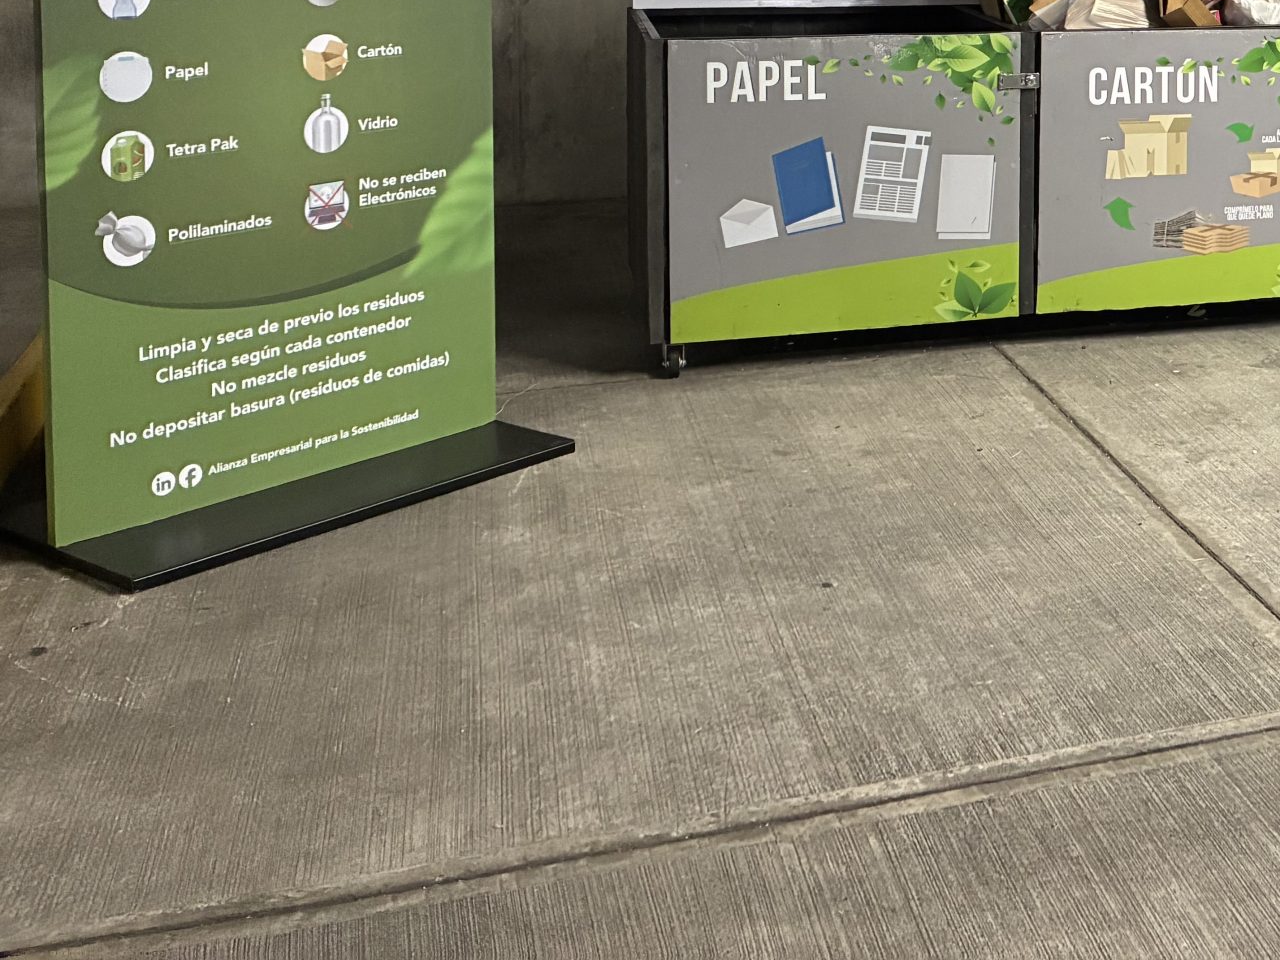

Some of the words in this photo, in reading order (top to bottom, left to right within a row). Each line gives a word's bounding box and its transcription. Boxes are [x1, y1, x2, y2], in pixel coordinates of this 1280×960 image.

[357, 44, 403, 59] Cartón
[165, 63, 209, 82] Papel
[705, 59, 827, 104] PAPEL
[1087, 58, 1220, 106] CARTÓN
[358, 116, 398, 131] Vidrio
[166, 141, 207, 157] Tetra
[211, 136, 239, 151] Pak
[359, 177, 379, 190] No
[382, 176, 397, 187] se
[400, 168, 447, 184] reciben
[359, 186, 437, 207] Electrónicos
[168, 213, 273, 243] Polilaminados
[138, 340, 197, 362] Limpia
[200, 336, 212, 352] y
[216, 327, 253, 345] seca
[258, 319, 280, 336] de
[283, 310, 334, 332] previo
[337, 303, 361, 318] los
[363, 290, 425, 312] residuos
[155, 359, 227, 384] Clasifica
[231, 344, 281, 368] según
[285, 336, 322, 355] cada
[325, 315, 412, 345] contenedor
[210, 381, 237, 397] No
[241, 366, 298, 389] mezcle
[302, 350, 367, 375] residuos
[109, 431, 137, 447] No
[142, 409, 226, 439] depositar
[230, 393, 286, 417] basura
[289, 376, 360, 404] (residuos
[363, 369, 383, 384] de
[386, 351, 450, 378] comidas)
[208, 458, 248, 475] Alianza
[250, 440, 313, 464] Empresarial
[314, 433, 339, 449] para
[340, 429, 350, 439] la
[351, 409, 419, 437] Sostenibilidad
